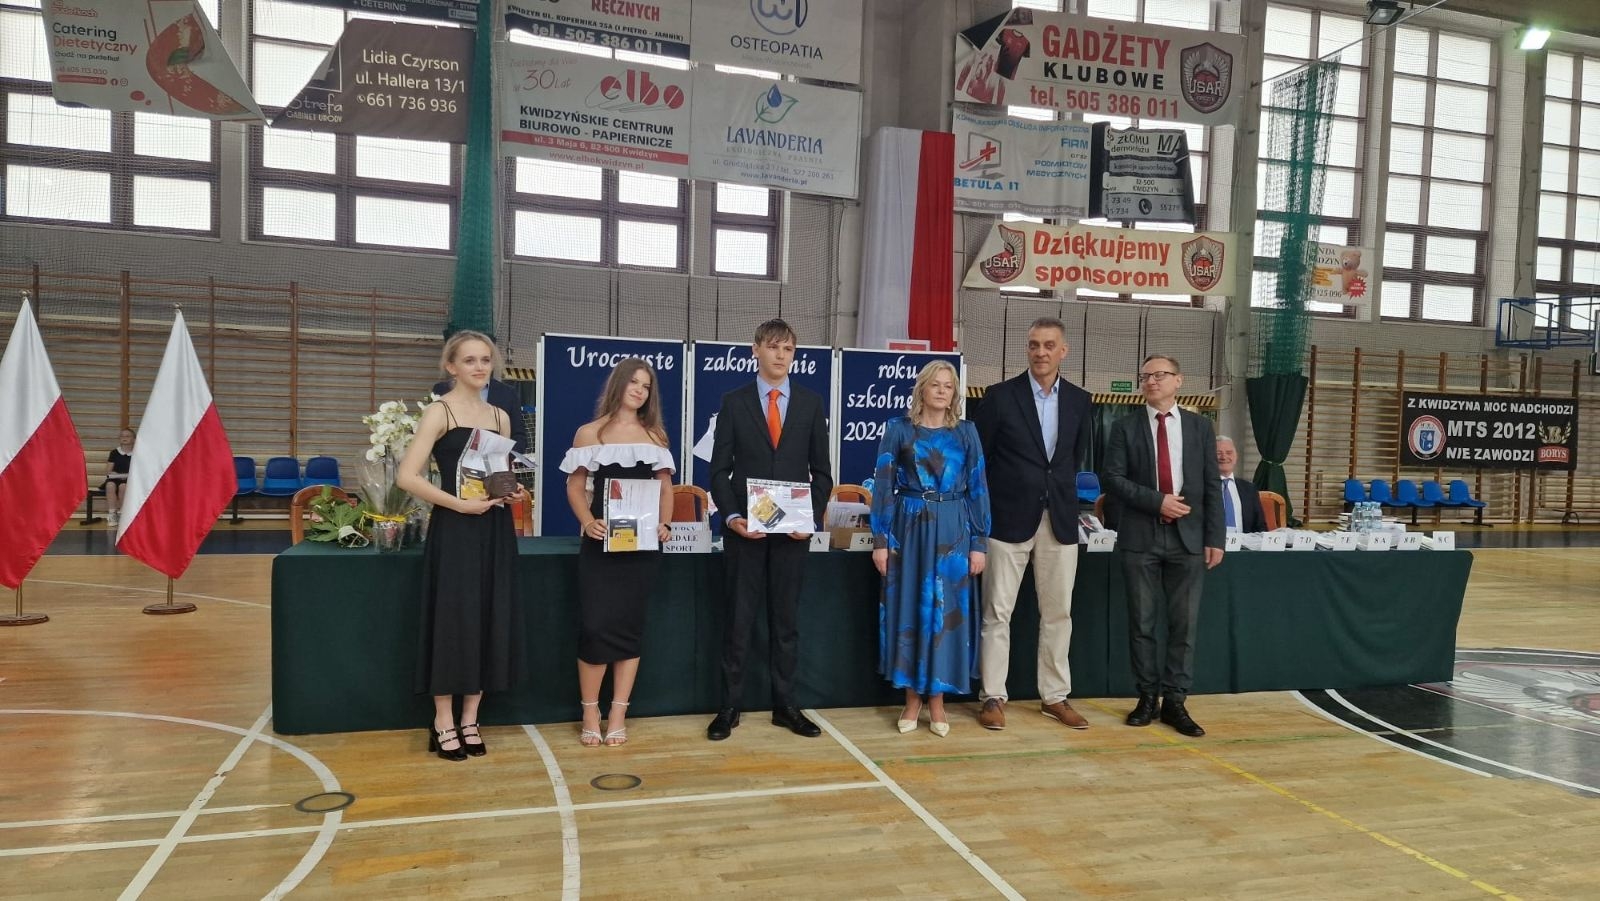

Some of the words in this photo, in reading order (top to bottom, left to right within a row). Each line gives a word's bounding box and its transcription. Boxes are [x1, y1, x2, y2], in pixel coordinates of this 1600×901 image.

[53, 22, 117, 41] Catering
[556, 16, 597, 27] KOPERNIKA
[54, 35, 138, 55] Dietetyczny
[532, 24, 560, 38] tel.
[565, 29, 595, 43] 505
[601, 33, 630, 49] 386
[634, 39, 662, 54] 011
[730, 35, 823, 60] OSTEOPATIA
[1042, 25, 1171, 70] GADŻETY
[363, 49, 397, 65] Lidia
[401, 53, 459, 71] Czyrson
[355, 71, 373, 85] ul.
[378, 72, 429, 90] Hallera
[434, 78, 465, 94] 13/1
[522, 69, 556, 91] 30
[1043, 61, 1164, 90] KLUBOWE
[600, 69, 685, 109] elbo
[1188, 77, 1222, 97] USAR
[366, 93, 392, 108] 661
[399, 95, 426, 111] 736
[431, 98, 457, 113] 936
[1030, 85, 1059, 107] tel.
[1067, 89, 1100, 112] 505
[1107, 93, 1141, 116] 386
[1147, 97, 1178, 119] 011
[520, 105, 609, 127] KWIDZYŃSKIE
[612, 118, 674, 135] CENTRUM
[519, 119, 580, 136] BIUROWO
[592, 129, 673, 148] PAPIERNICZE
[556, 138, 578, 148] Maja
[727, 126, 823, 154] LAVANDERIA
[1060, 138, 1088, 149] FIRM
[1117, 134, 1149, 145] ZŁOMU
[954, 178, 1003, 190] BETULA
[1033, 230, 1171, 266] Dziękujemy
[1035, 265, 1169, 287] sponsorom
[1189, 263, 1216, 278] USAR
[567, 345, 675, 370] Urocste
[703, 346, 816, 375] zakońnie
[878, 355, 919, 380] roku
[1407, 397, 1416, 408] Z
[1418, 398, 1481, 412] KWIDZYNA
[1483, 402, 1507, 413] MOC
[1510, 403, 1574, 415] NADCHODZI
[1447, 420, 1488, 438] MTS
[1492, 421, 1536, 440] 2012
[1446, 447, 1471, 460] NIE
[1474, 448, 1535, 462] ZAWODZI
[1540, 447, 1567, 459] BORYS
[671, 534, 697, 542] EDALE
